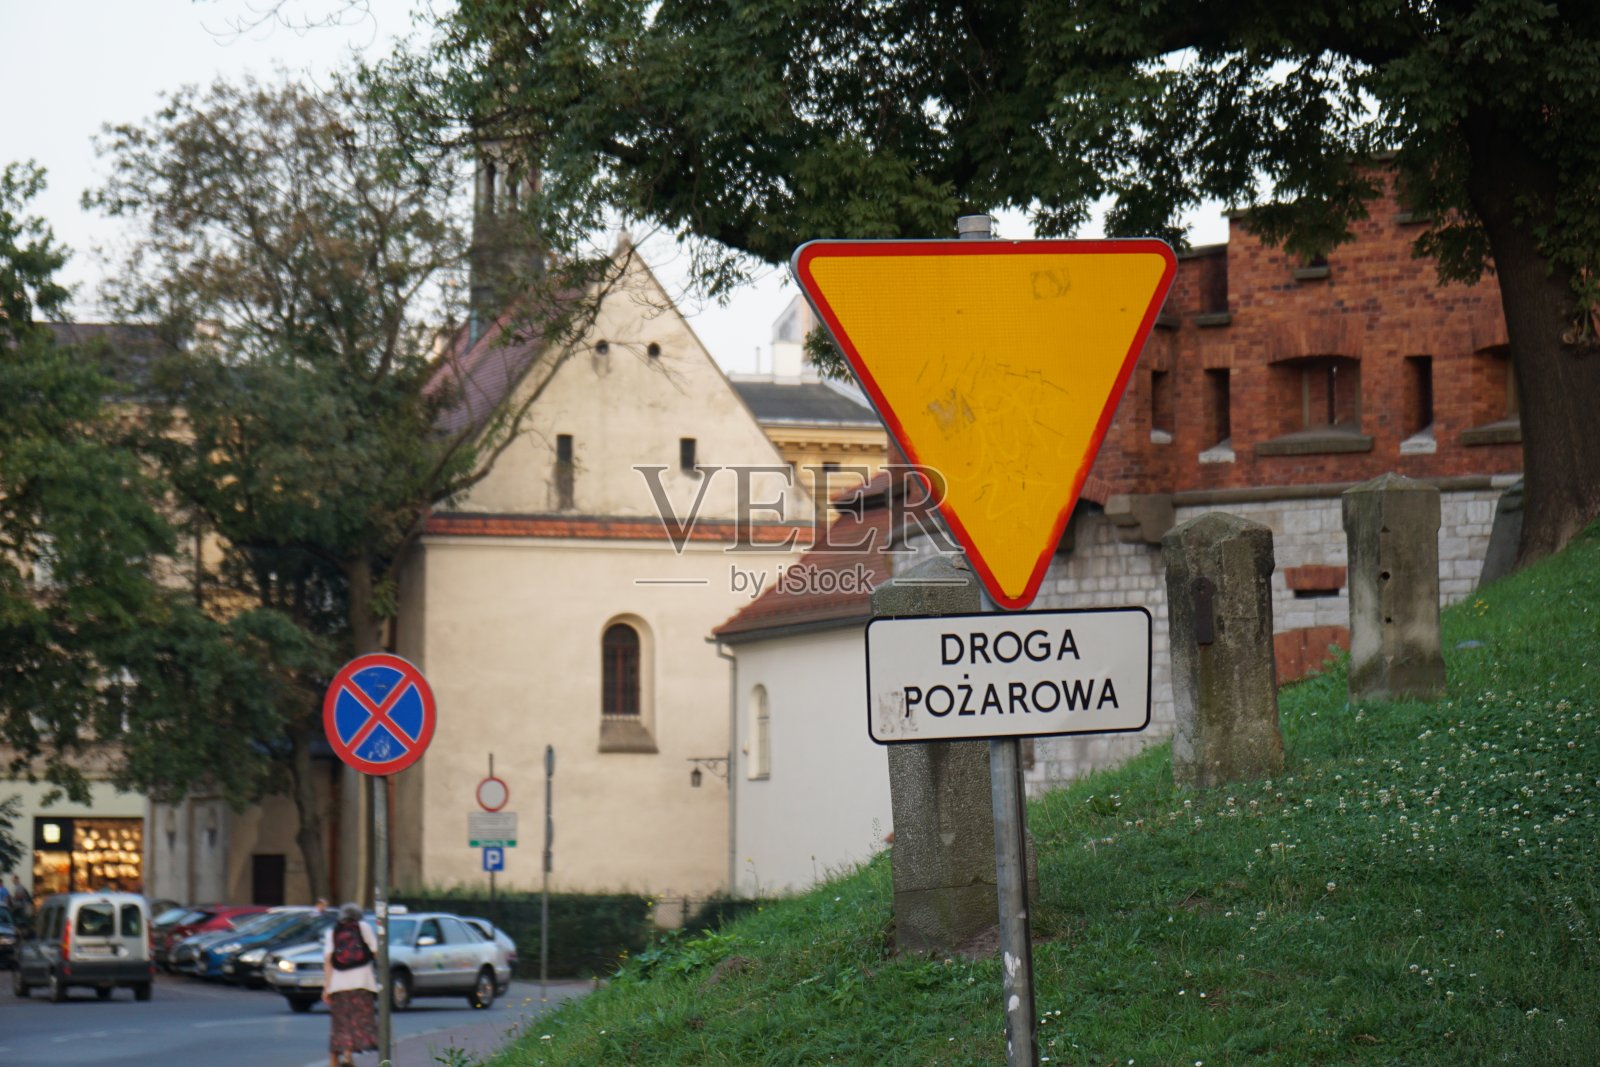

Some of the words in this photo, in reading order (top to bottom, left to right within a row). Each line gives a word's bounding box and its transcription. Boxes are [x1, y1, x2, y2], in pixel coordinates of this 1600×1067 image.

[941, 629, 1080, 666] DROGA
[903, 673, 1119, 718] POŻAROWA
[486, 850, 501, 870] P
